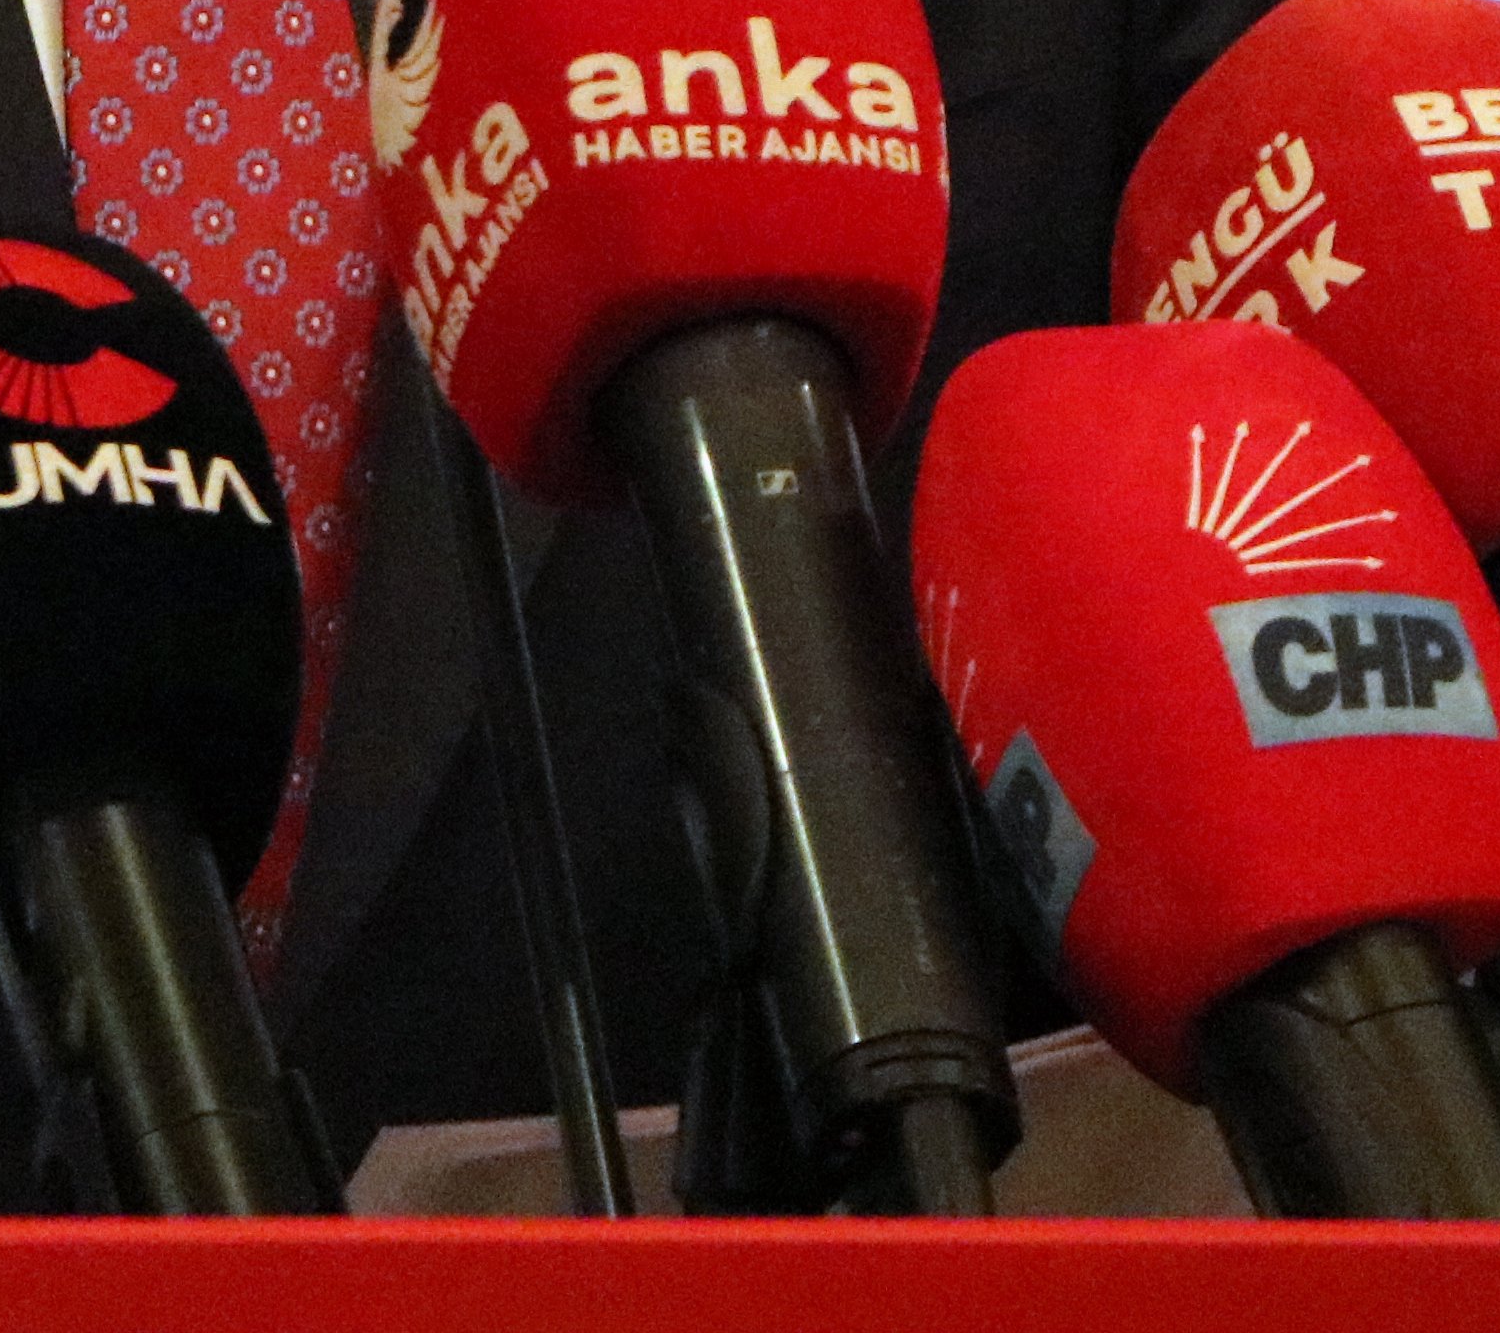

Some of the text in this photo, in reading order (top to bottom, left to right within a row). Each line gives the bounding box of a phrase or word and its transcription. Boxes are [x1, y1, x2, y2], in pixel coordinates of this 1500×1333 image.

[565, 16, 920, 132] anka
[573, 123, 922, 176] HABER AJANSI
[1145, 132, 1314, 325] ENGÜ
[1250, 612, 1467, 718] CHP
